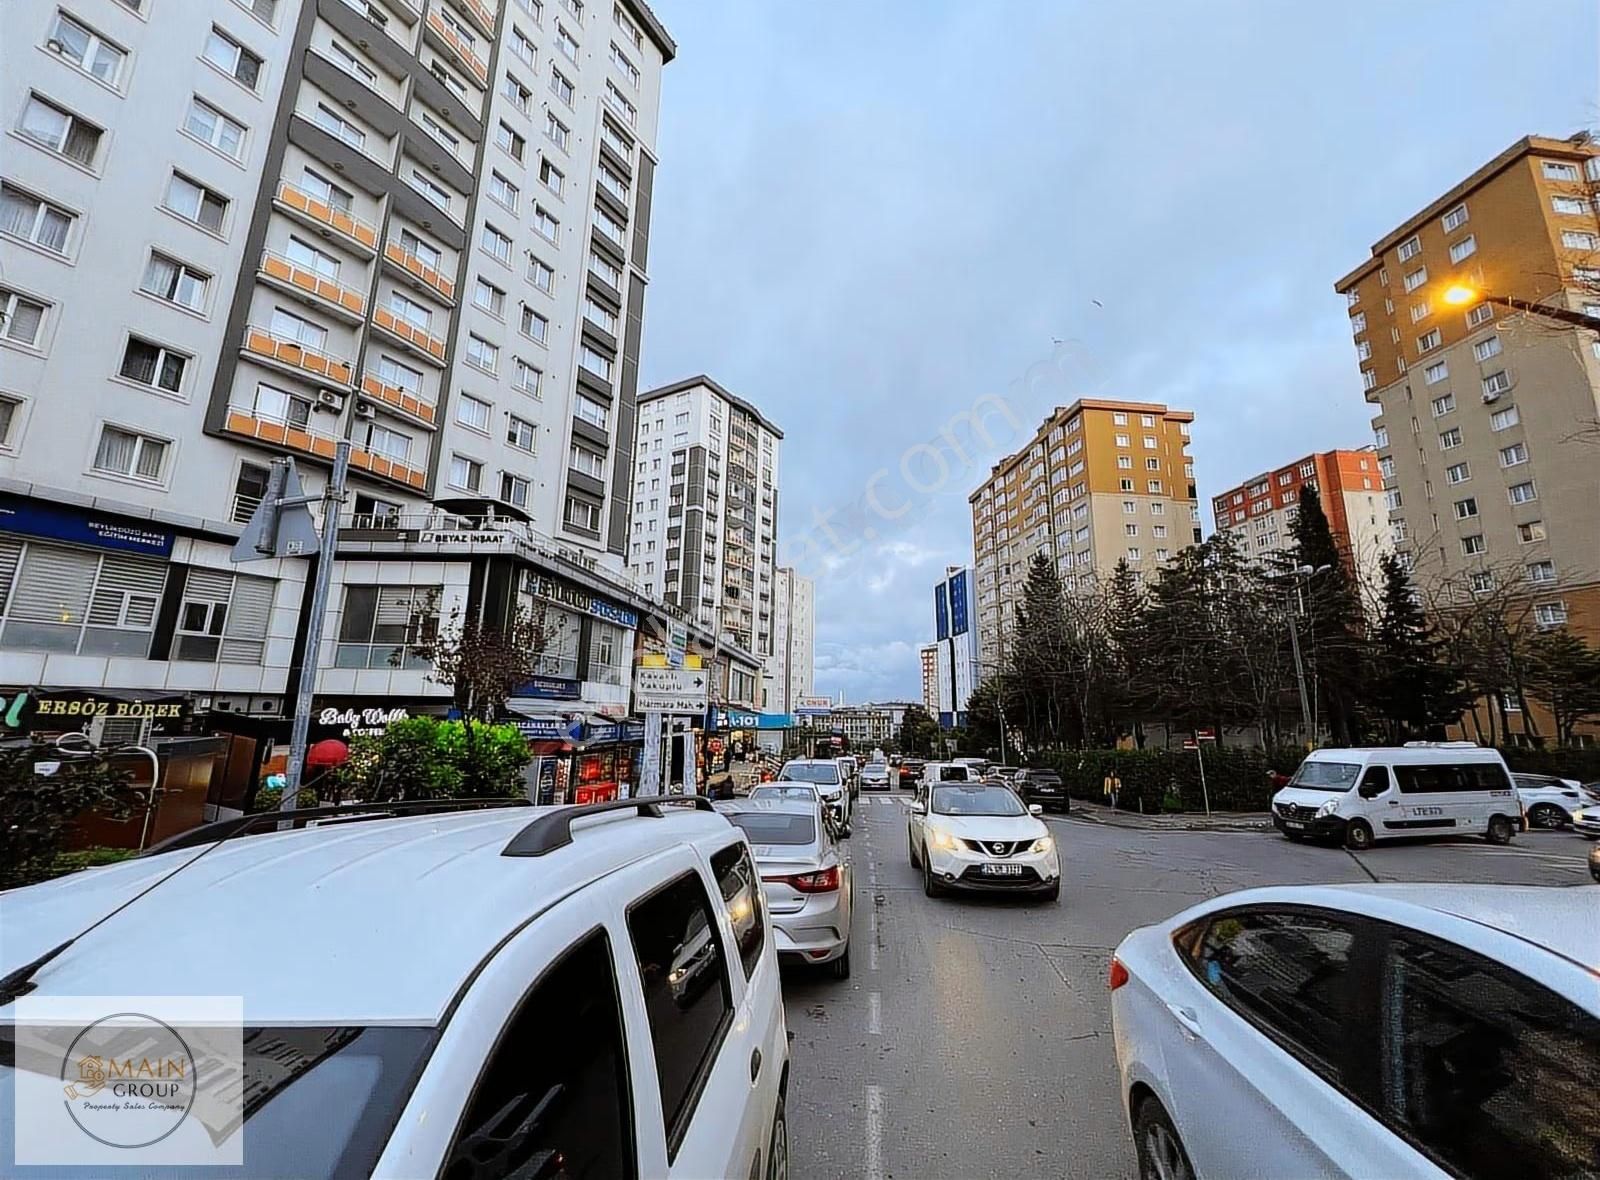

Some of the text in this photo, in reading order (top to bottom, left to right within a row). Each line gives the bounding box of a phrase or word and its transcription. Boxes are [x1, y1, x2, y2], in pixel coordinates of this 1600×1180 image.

[435, 534, 467, 543] BEYAZ
[36, 698, 109, 716] ERSÖZ
[116, 700, 182, 718] BÖREK
[319, 708, 361, 729] Baby
